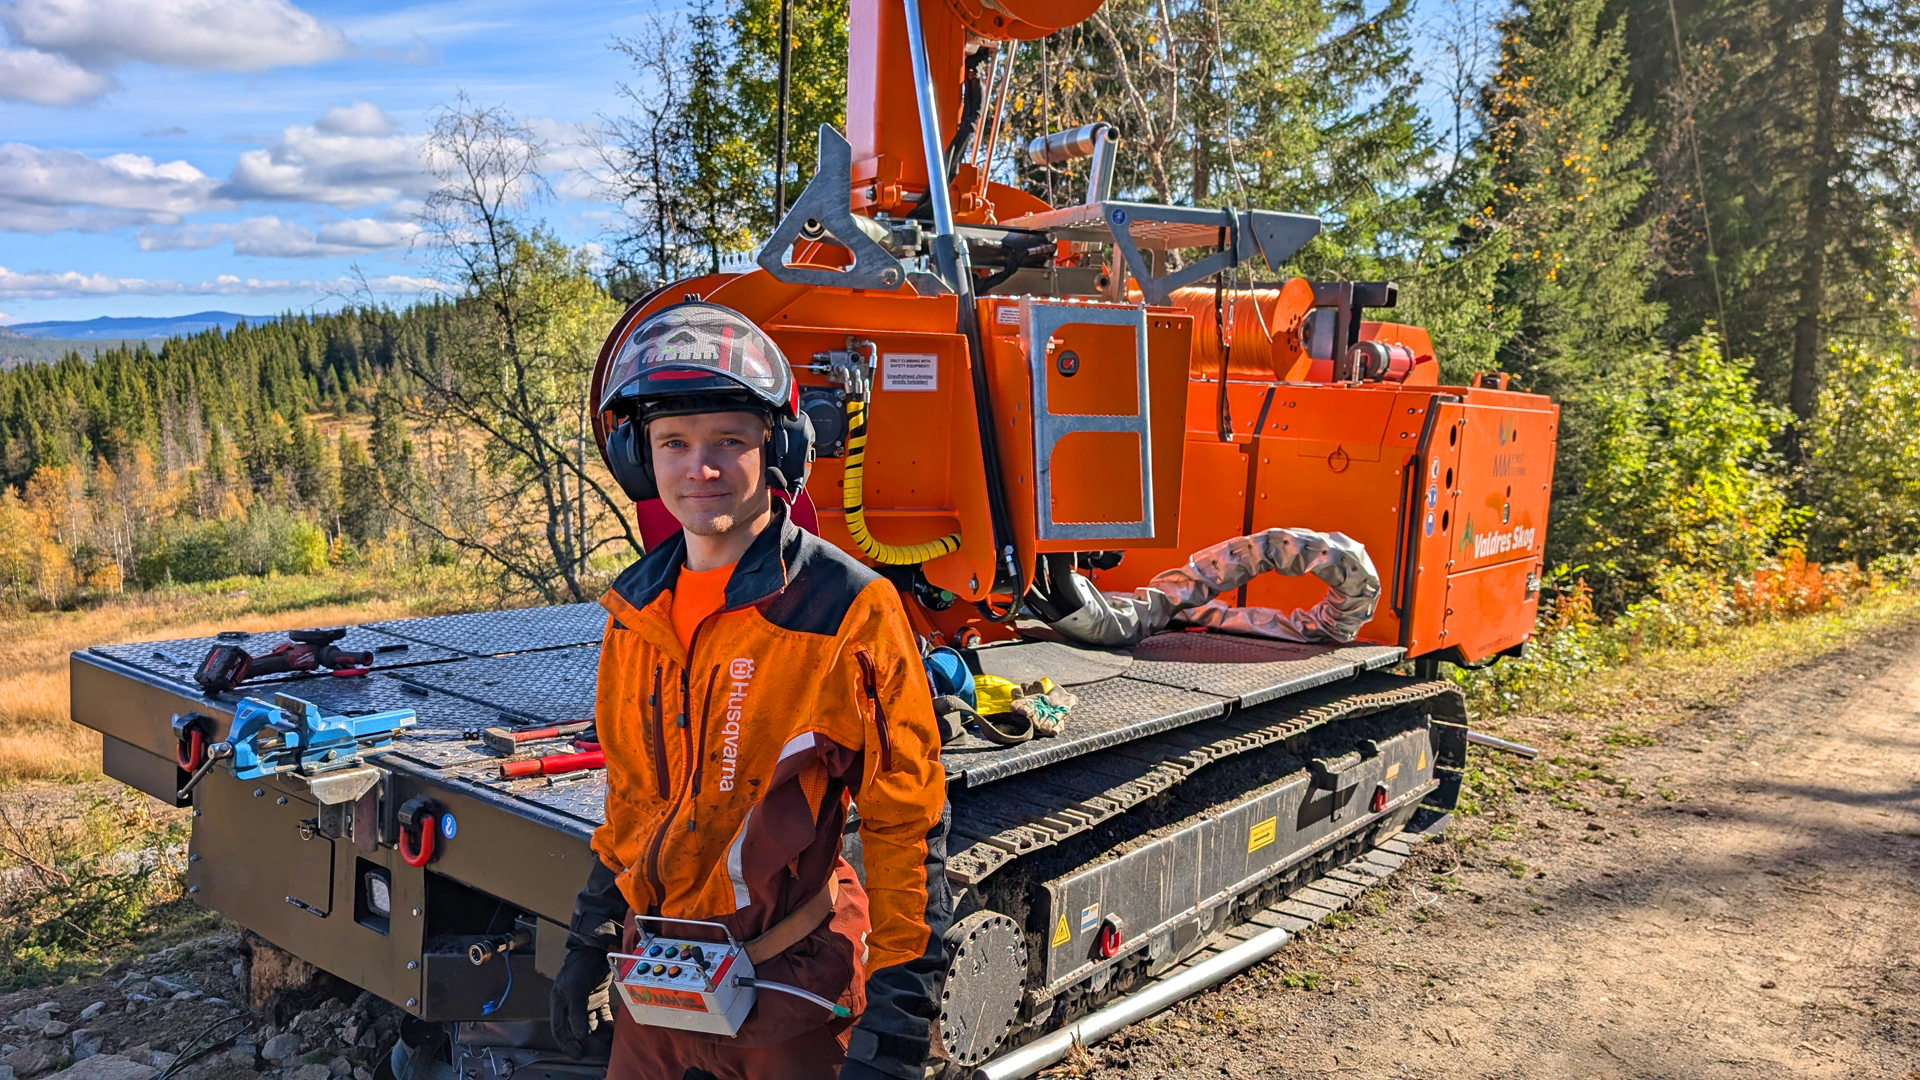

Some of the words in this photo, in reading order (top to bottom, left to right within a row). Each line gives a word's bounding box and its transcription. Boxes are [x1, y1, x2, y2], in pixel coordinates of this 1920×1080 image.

[1473, 529, 1512, 559] Valdres
[1512, 524, 1536, 552] Skog
[719, 681, 749, 792] Husqvarna
